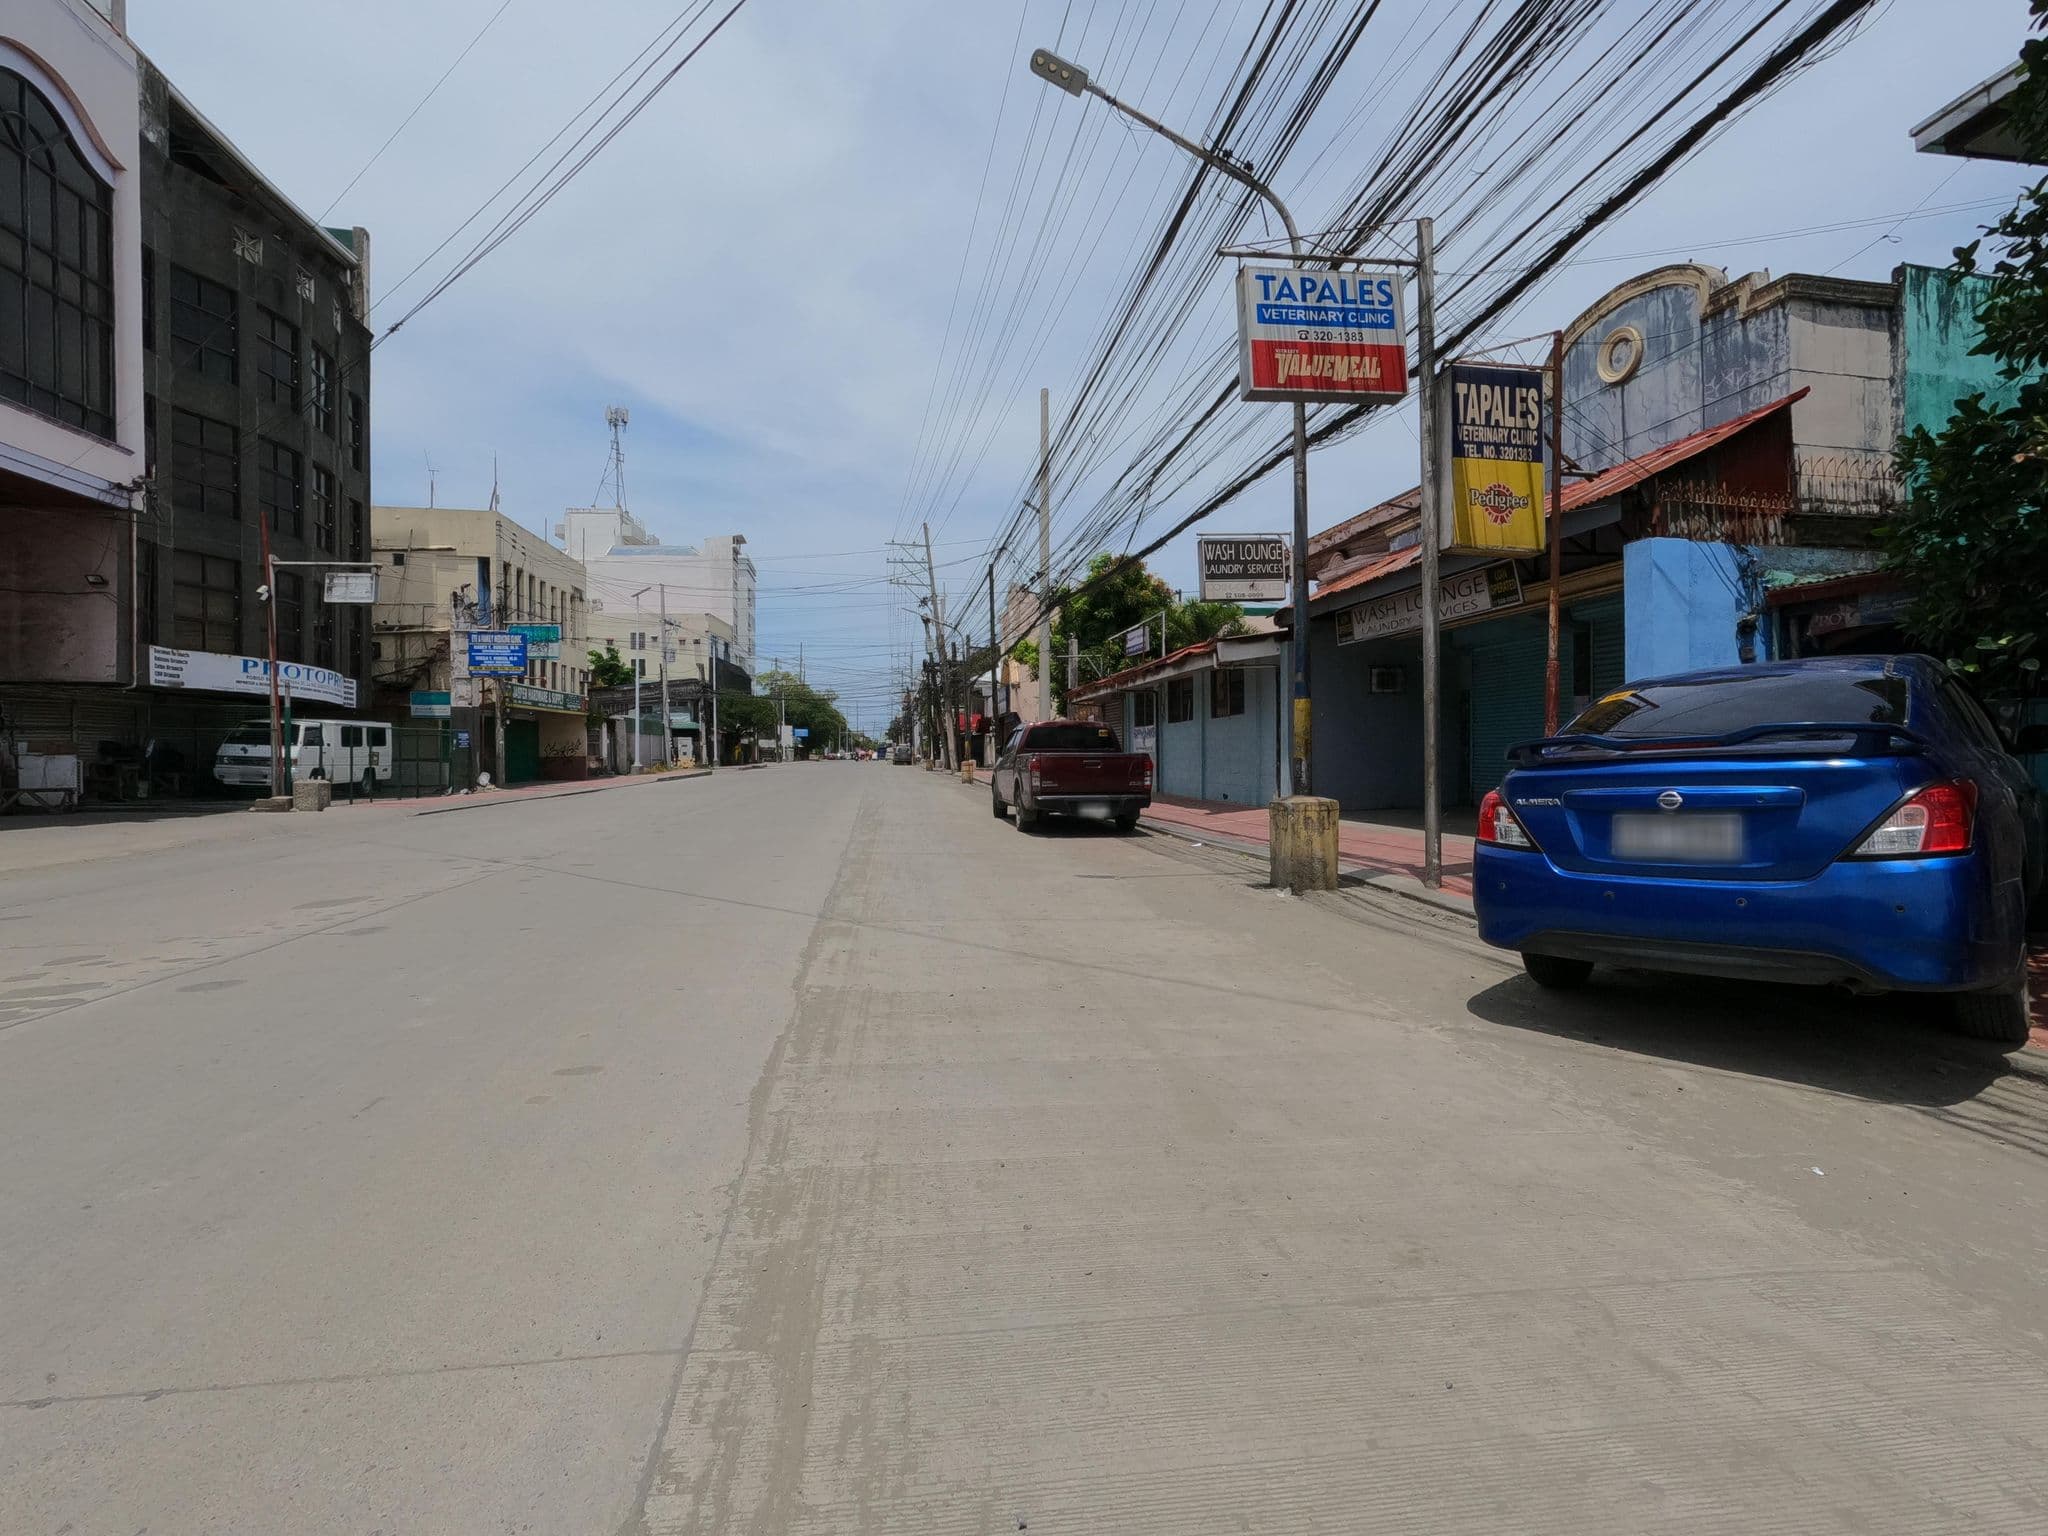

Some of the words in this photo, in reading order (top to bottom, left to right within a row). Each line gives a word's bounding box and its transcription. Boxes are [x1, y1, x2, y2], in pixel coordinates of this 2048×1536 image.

[1255, 274, 1394, 307] TAPALES
[1262, 308, 1345, 323] VETERINARY
[1348, 312, 1391, 324] CLINIC
[1313, 331, 1364, 342] 320-1383
[1455, 382, 1539, 430] TAPALES
[1457, 425, 1509, 444] VETERINARY
[1510, 429, 1538, 446] CLINIC
[1463, 444, 1482, 458] TEL.
[1483, 445, 1498, 459] NO.
[1500, 446, 1533, 462] 3201383
[1470, 488, 1529, 511] Pedigree
[1204, 543, 1235, 560] WASH
[1240, 543, 1282, 560] LOUNGE
[1205, 563, 1244, 574] LAUNDRY
[1247, 563, 1283, 574] SERVICES
[1352, 601, 1398, 625] WASH
[1516, 798, 1561, 806] ALMERA
